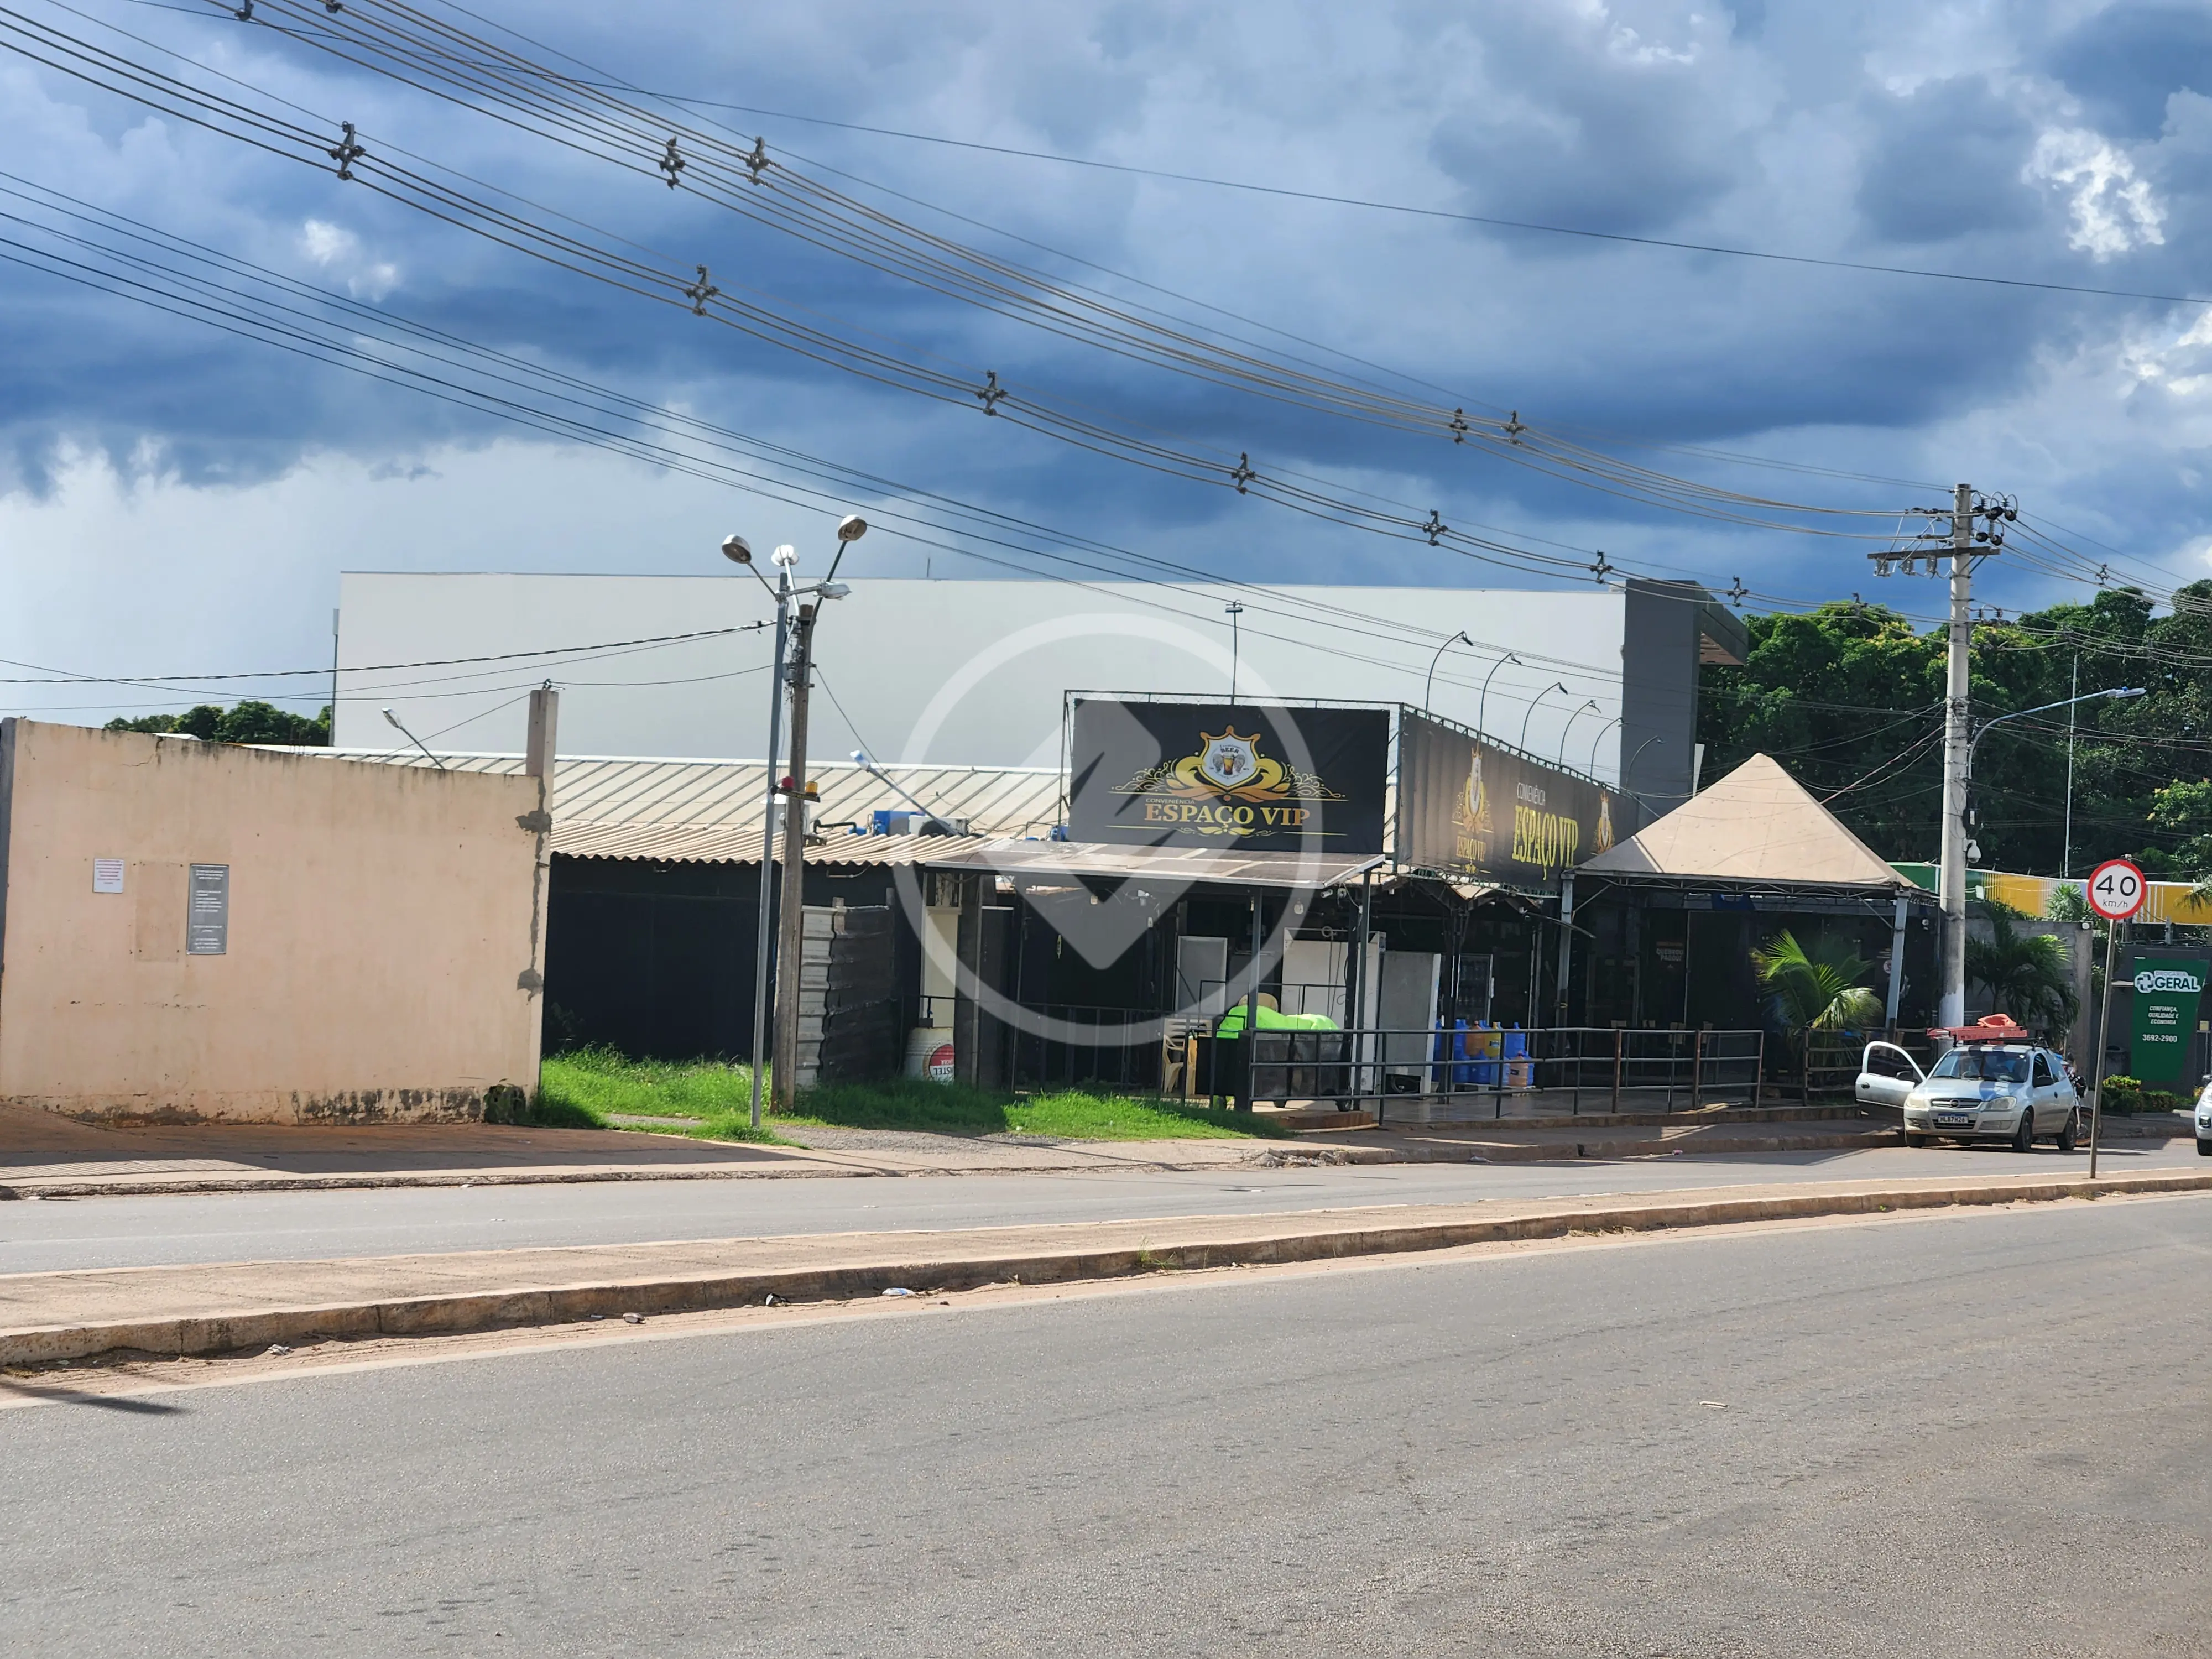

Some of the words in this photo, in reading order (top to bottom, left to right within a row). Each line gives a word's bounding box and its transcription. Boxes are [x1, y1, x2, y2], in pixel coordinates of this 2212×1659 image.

[1144, 804, 1254, 828] ESPAÇO
[1260, 807, 1310, 826] VIP
[1512, 805, 1557, 880] ESPAÇO
[1559, 816, 1578, 869] VIP
[2096, 875, 2136, 896] 40
[2103, 899, 2128, 907] km/h
[2155, 977, 2198, 990] GERAL
[2142, 1034, 2178, 1042] 3692-2900
[933, 1067, 953, 1076] STEL
